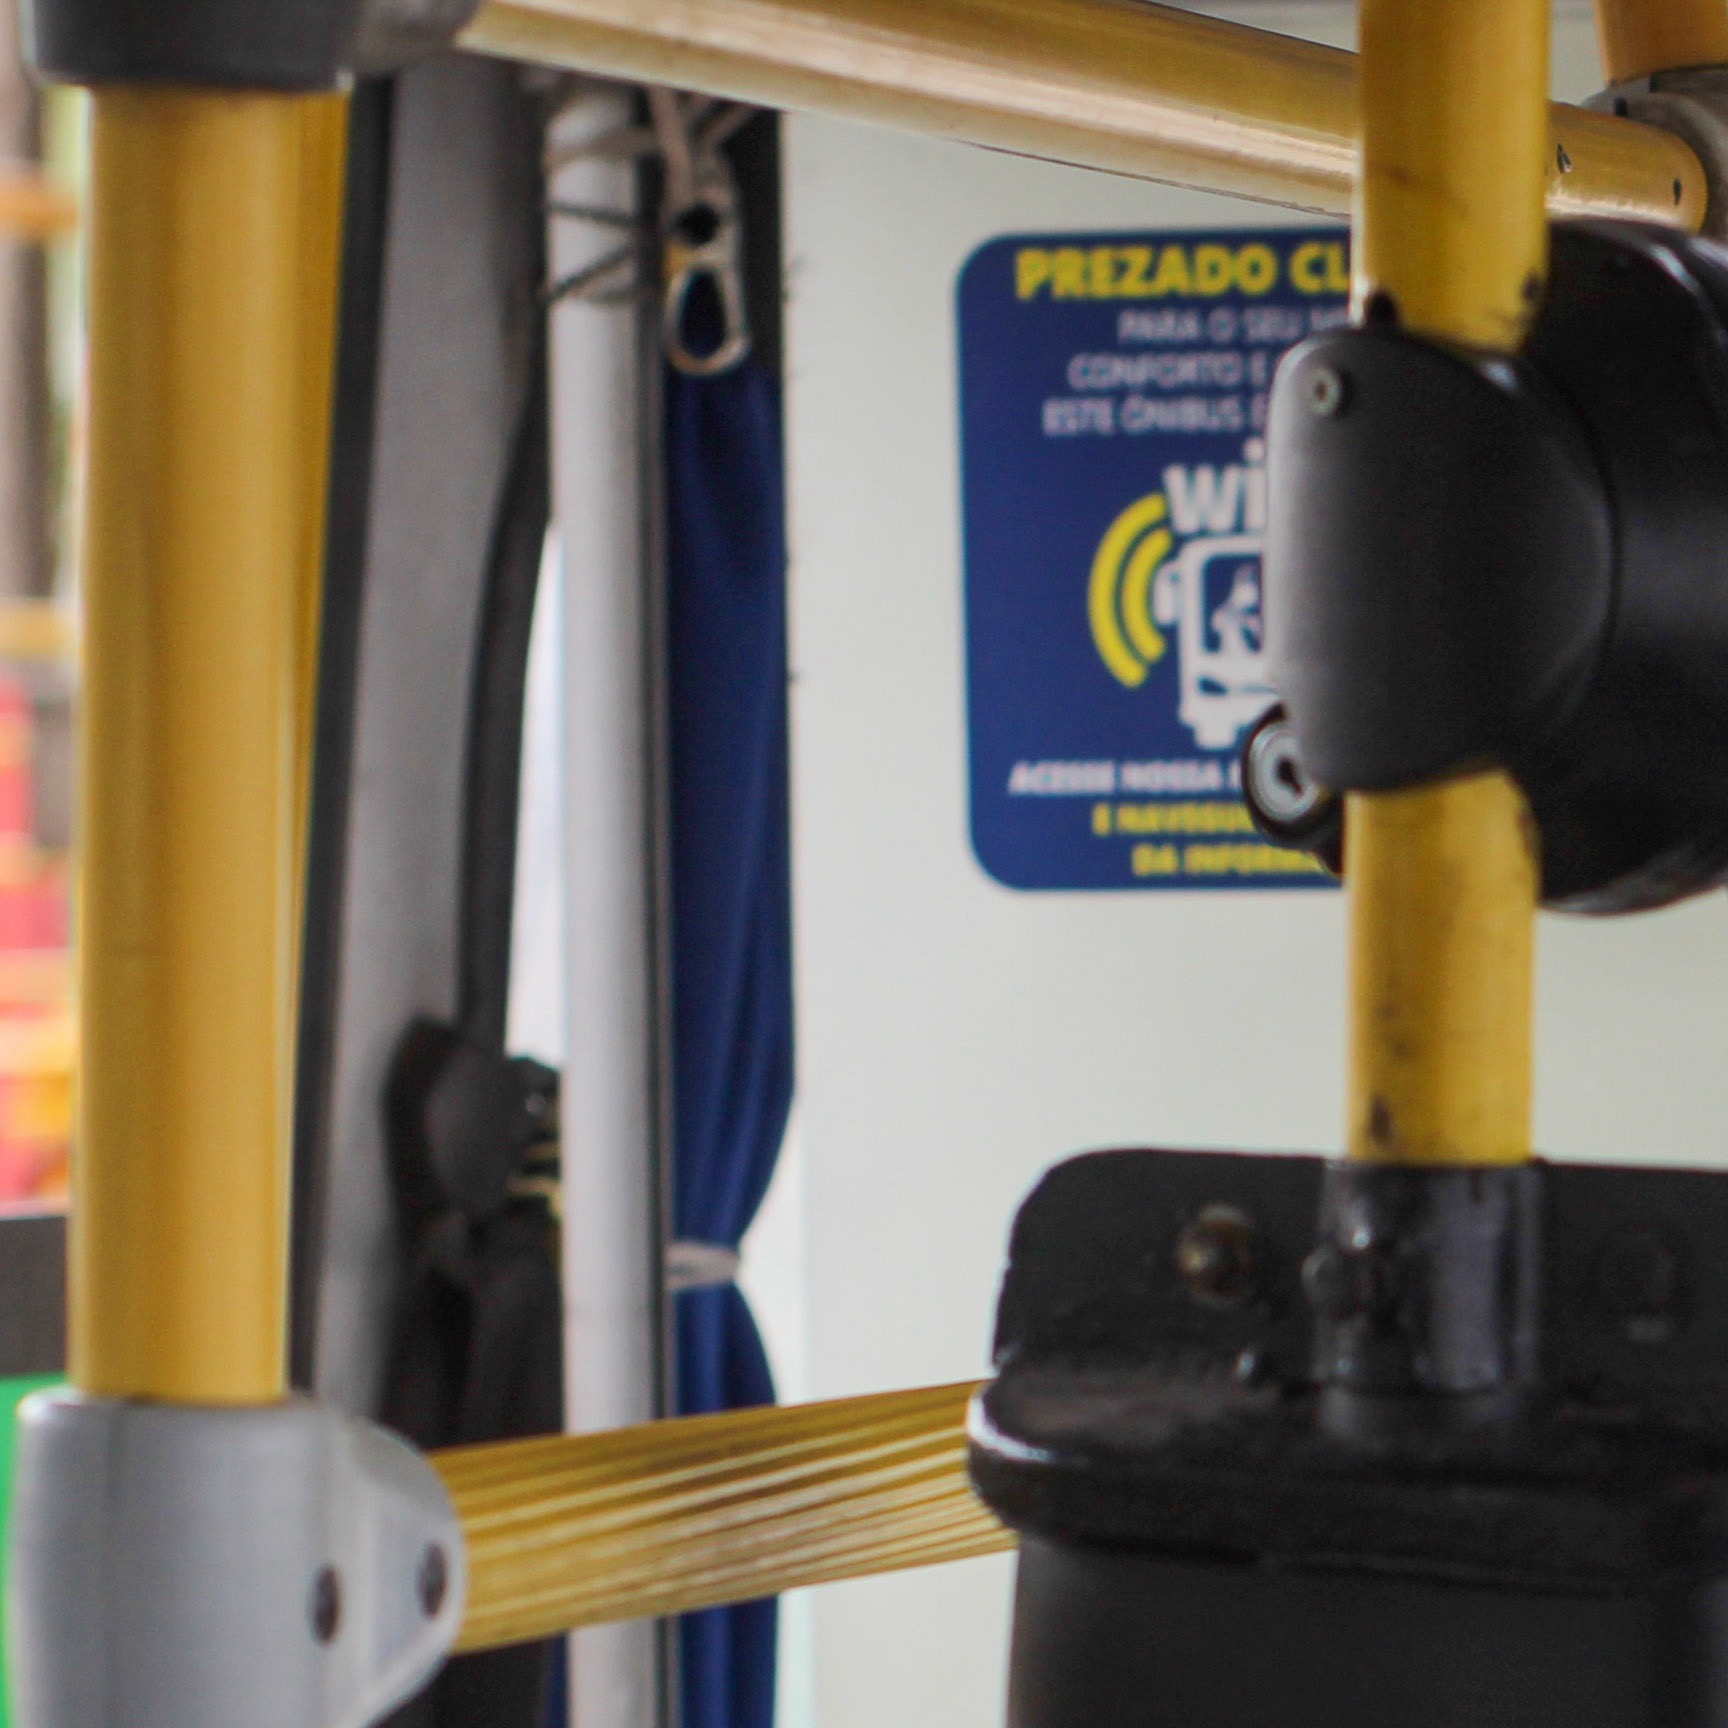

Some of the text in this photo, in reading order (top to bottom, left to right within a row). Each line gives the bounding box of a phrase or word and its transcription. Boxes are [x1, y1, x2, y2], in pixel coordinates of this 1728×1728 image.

[1015, 243, 1277, 301] PREZADO
[1118, 309, 1199, 343] PARA
[1209, 308, 1238, 342] O
[1068, 353, 1242, 390] CONFORTO
[1042, 398, 1114, 436] ESTE
